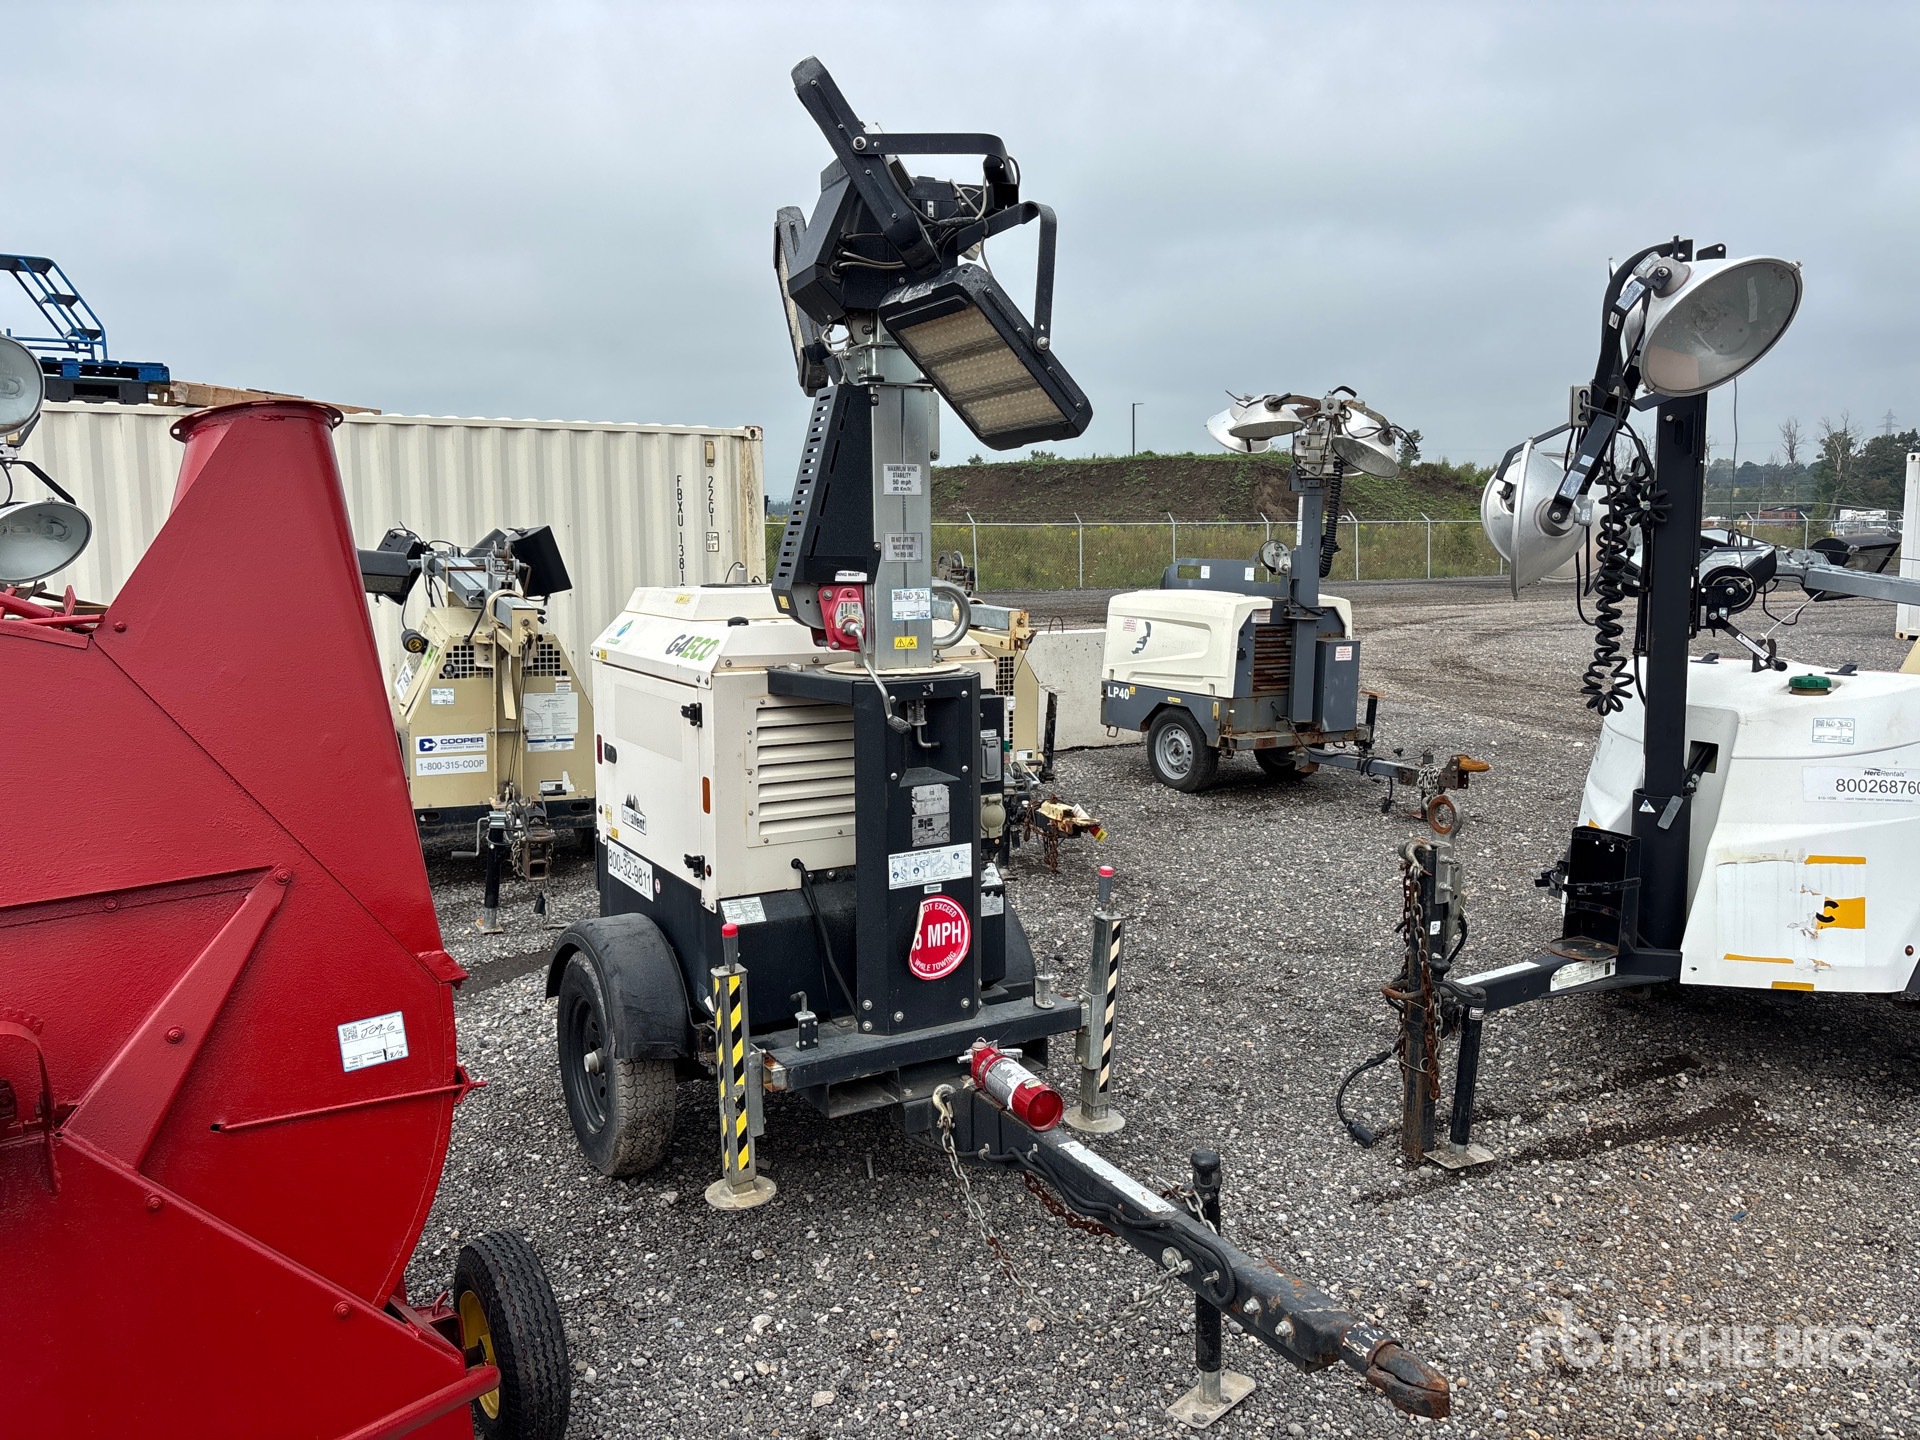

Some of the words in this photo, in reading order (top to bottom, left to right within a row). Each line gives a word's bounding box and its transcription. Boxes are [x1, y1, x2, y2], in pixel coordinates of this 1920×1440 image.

[665, 634, 720, 661] G4ECO
[1107, 685, 1130, 700] LP40
[440, 737, 484, 745] COOPER
[419, 760, 485, 770] 1-800-315-COOP
[608, 849, 651, 892] 800-32-9811
[935, 902, 957, 918] EXCEED
[927, 920, 961, 948] MPH
[932, 950, 957, 971] TOWING
